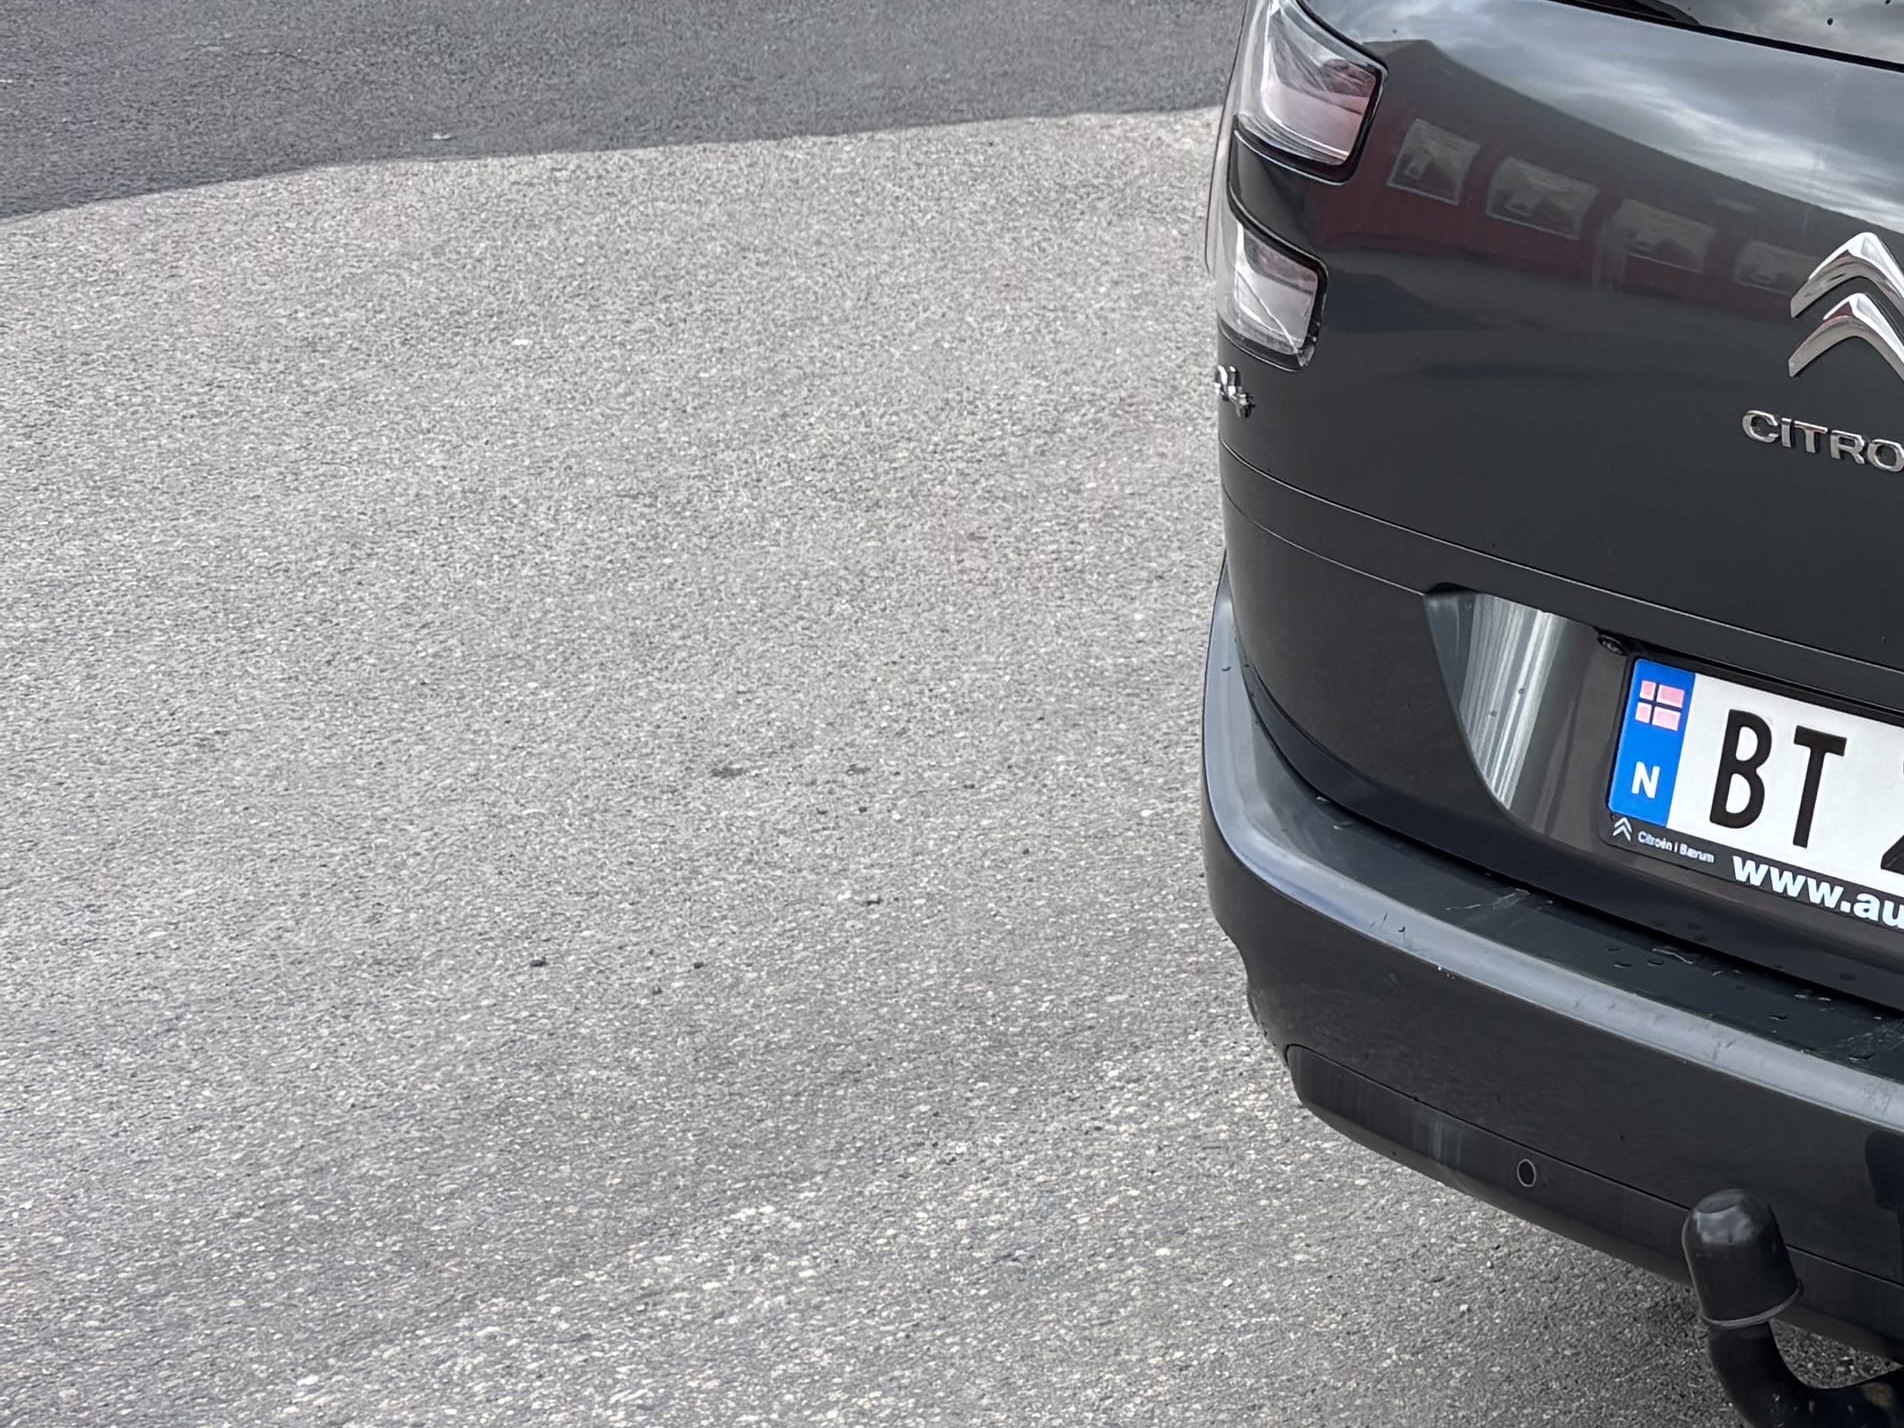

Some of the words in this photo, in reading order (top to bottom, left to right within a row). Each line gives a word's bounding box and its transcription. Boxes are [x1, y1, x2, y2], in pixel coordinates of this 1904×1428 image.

[1631, 760, 1661, 799] N
[1709, 708, 1847, 849] BT
[1638, 831, 1673, 853] Citroën
[1679, 843, 1715, 864] Bærum
